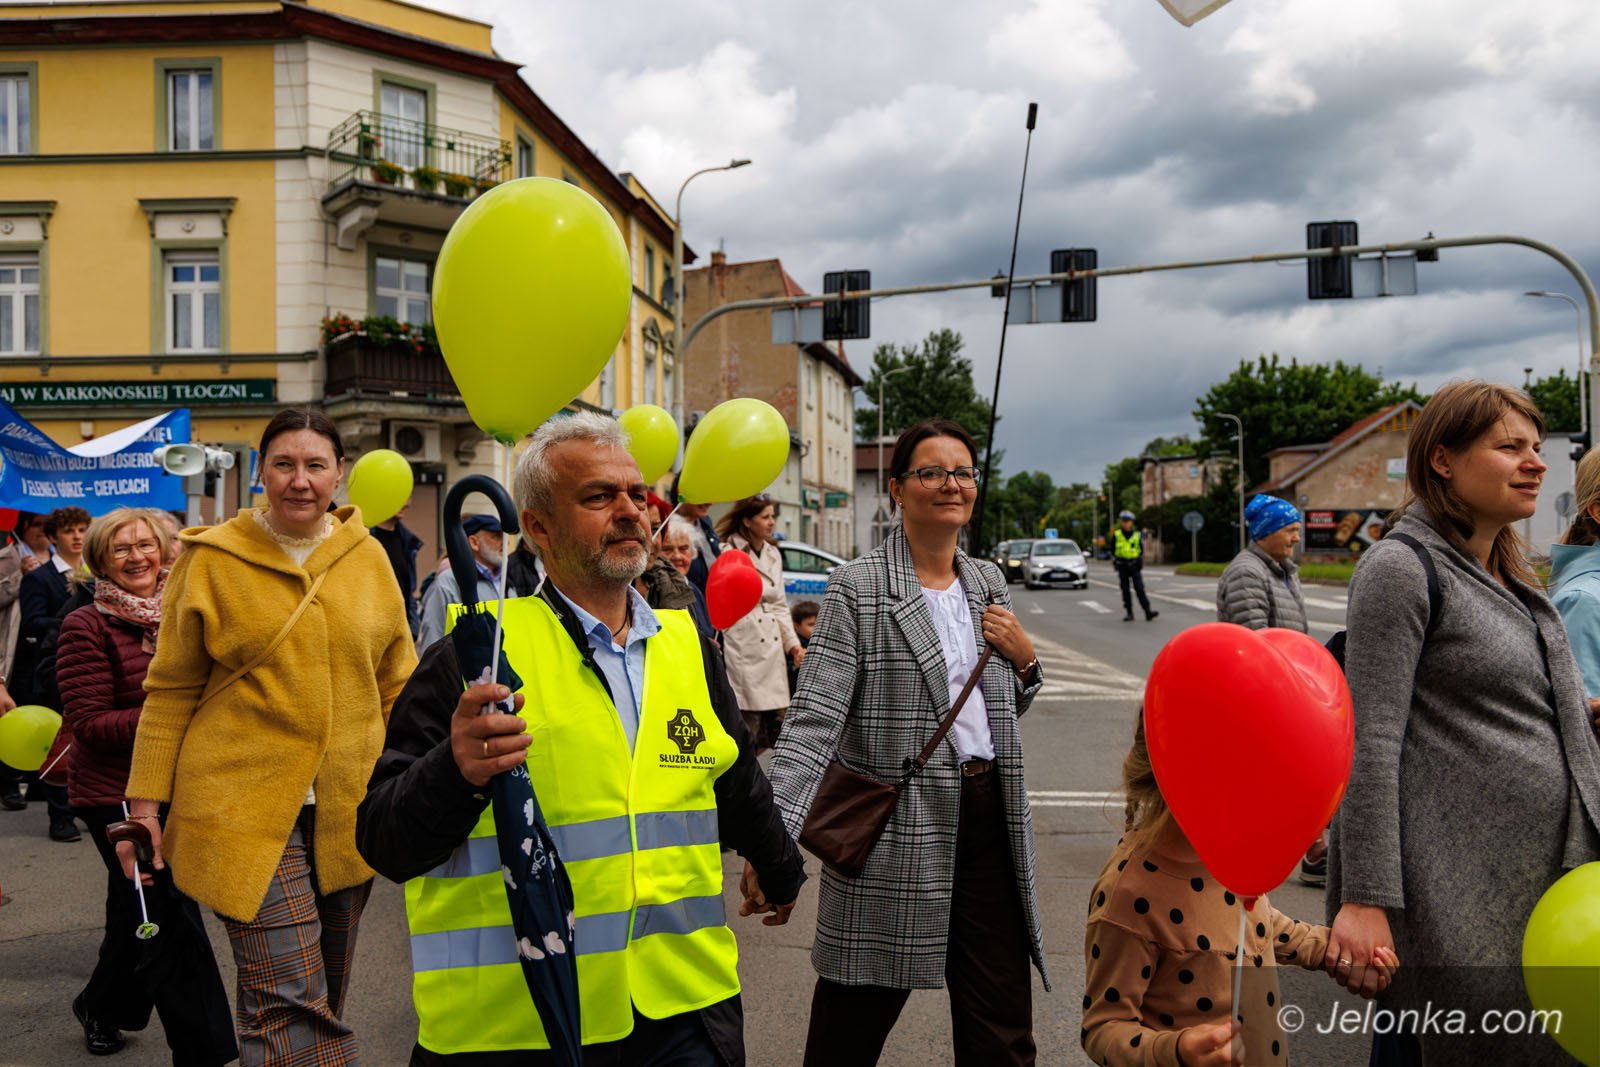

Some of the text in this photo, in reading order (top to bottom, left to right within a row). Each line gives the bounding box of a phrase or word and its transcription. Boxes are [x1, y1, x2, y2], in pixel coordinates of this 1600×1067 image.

[20, 387, 37, 400] W
[42, 385, 168, 401] KARKONOSKIEJ
[172, 384, 247, 399] TŁOCZNI
[99, 452, 160, 469] MIŁOSIERD
[94, 478, 150, 496] CIEPLICACH
[795, 582, 826, 592] POLICJ
[659, 753, 716, 765] SŁUŻBA ŁADU
